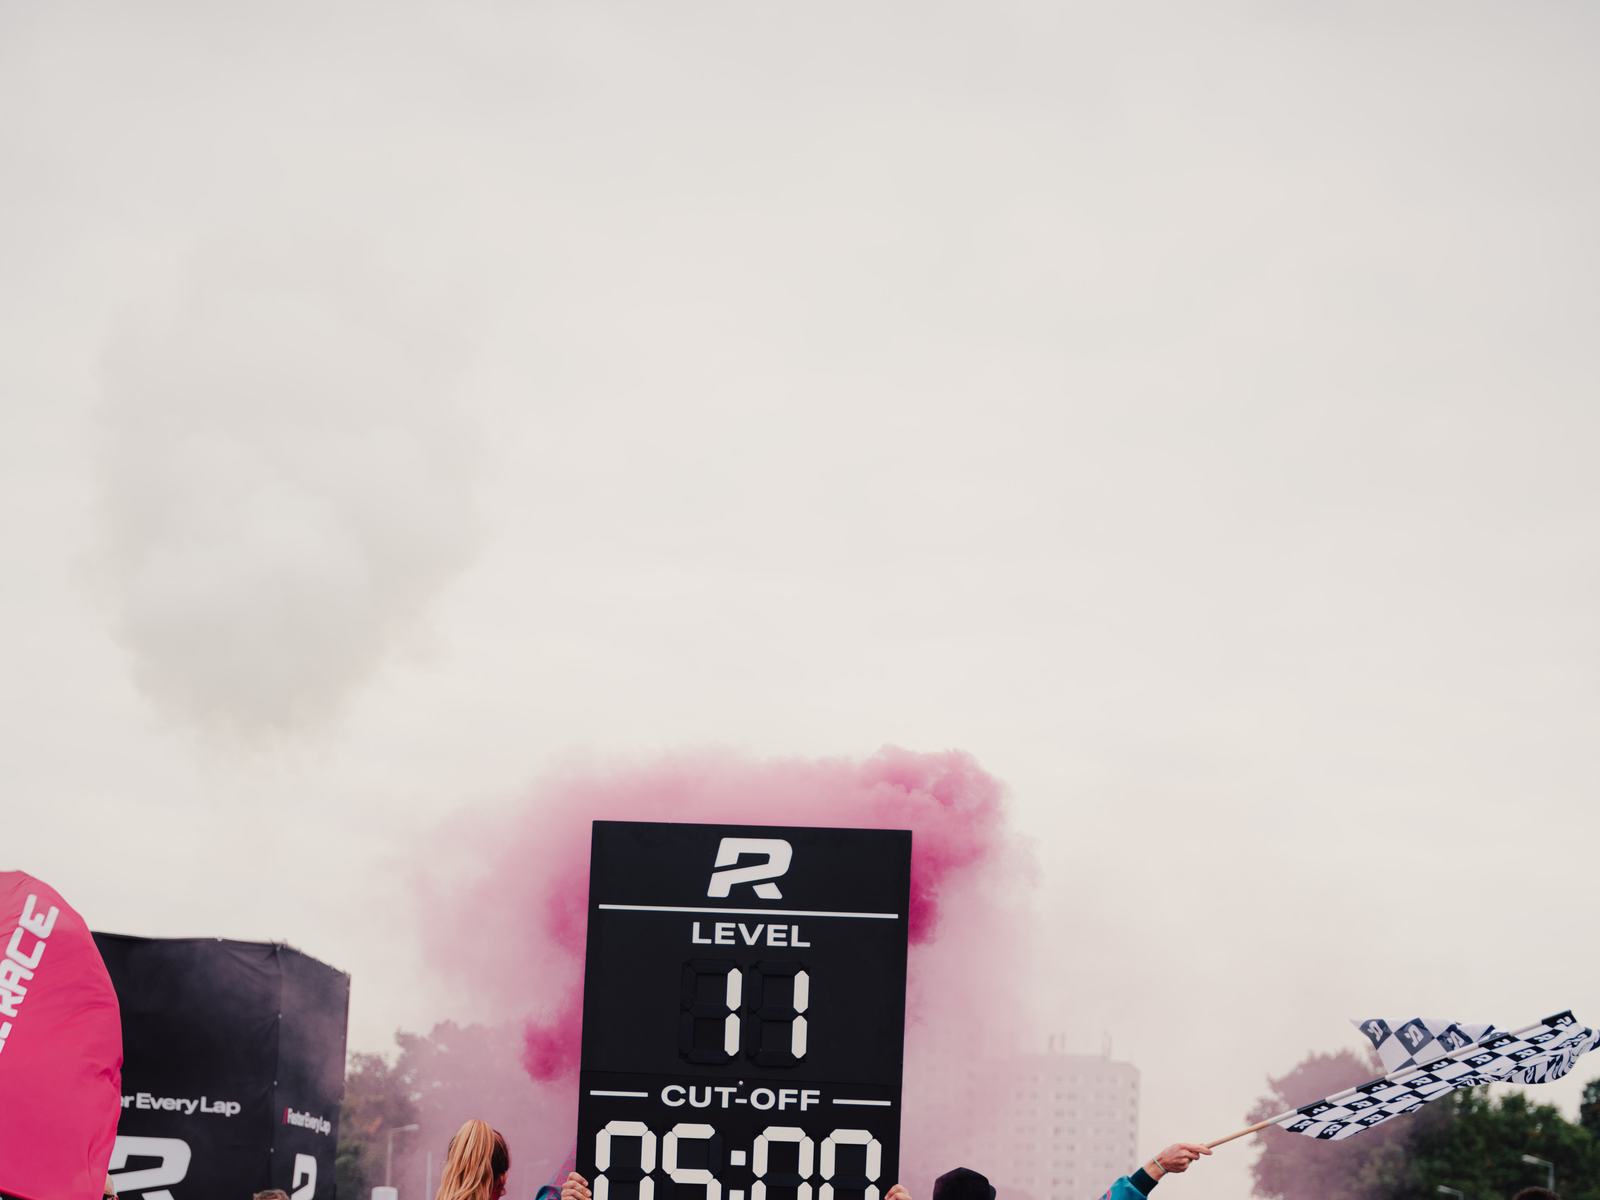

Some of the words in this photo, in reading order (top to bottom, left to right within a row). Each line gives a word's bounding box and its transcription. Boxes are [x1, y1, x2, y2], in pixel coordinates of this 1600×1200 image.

[692, 922, 811, 947] LEVEL
[724, 968, 809, 1059] 11
[136, 1092, 199, 1115] Every
[200, 1096, 241, 1117] Lap
[661, 1085, 820, 1111] CUT-OFF
